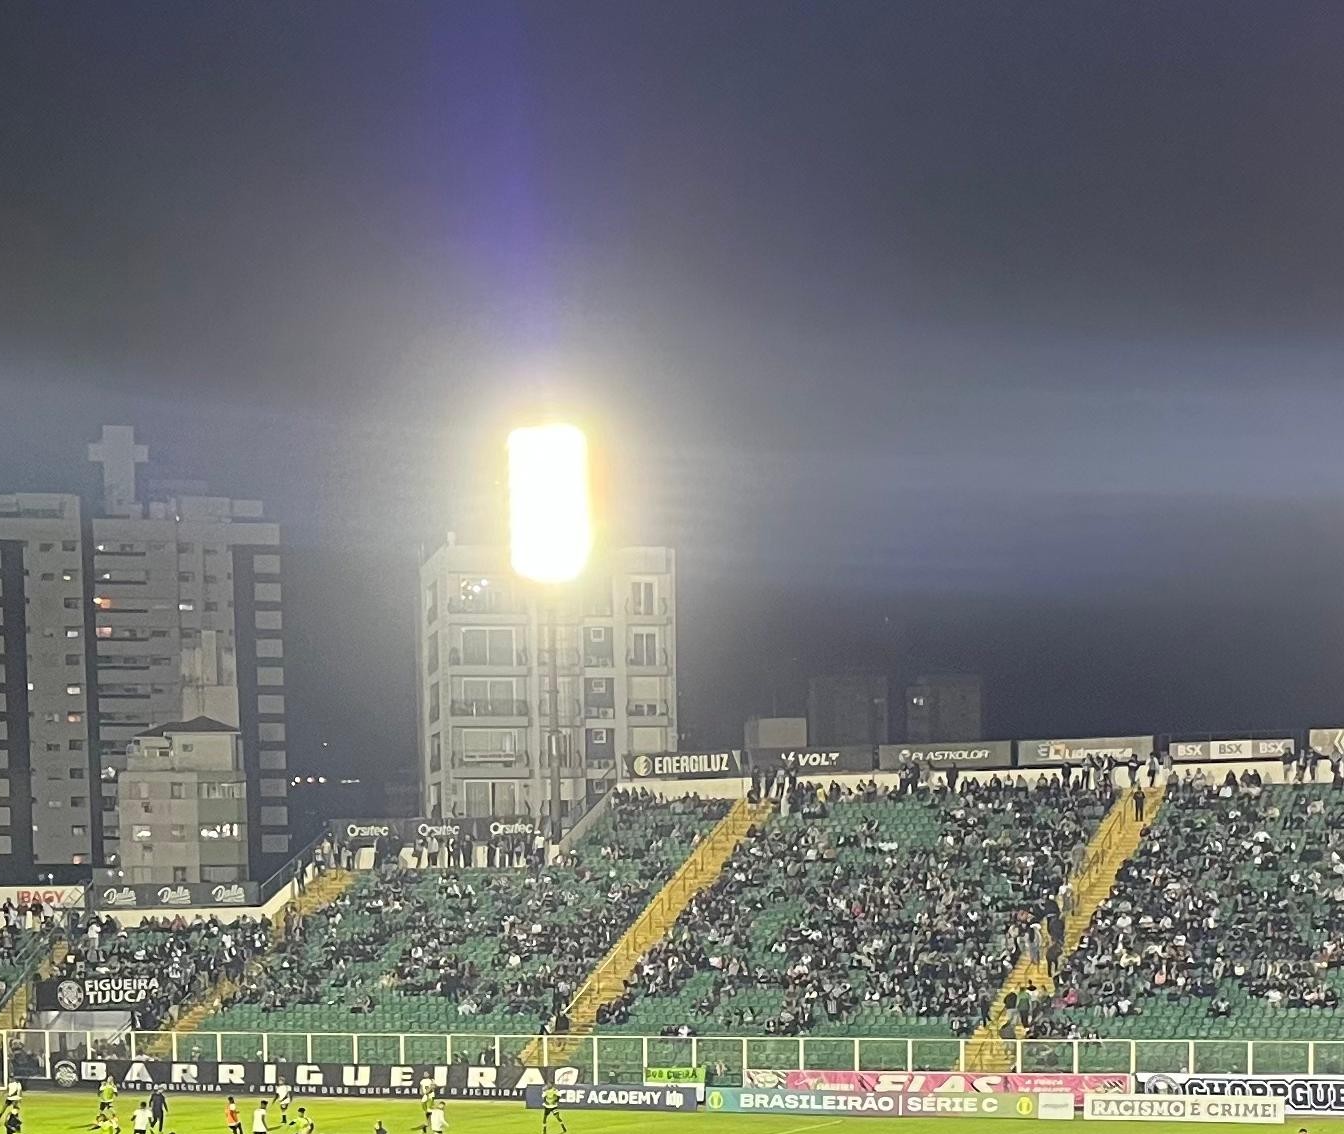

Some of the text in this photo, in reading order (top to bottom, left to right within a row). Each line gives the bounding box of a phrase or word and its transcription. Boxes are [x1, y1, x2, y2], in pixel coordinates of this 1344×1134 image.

[1178, 745, 1202, 756] BSX
[1219, 744, 1242, 754] BSX
[1259, 742, 1284, 754] BSX
[654, 754, 729, 774] ENERGILUZ
[798, 752, 840, 767] VOLT
[16, 890, 65, 904] IBAGY
[104, 887, 136, 904] Dalla
[158, 886, 191, 903] Dalla
[212, 884, 244, 902] Dalla
[84, 977, 159, 992] FIGUEIRA
[558, 1089, 585, 1104] CBF
[587, 1090, 662, 1105] ACADEMY
[740, 1092, 998, 1113] BRASILEIRÃO SÉRIE C
[1092, 1099, 1278, 1117] RACISMO É CRIME!
